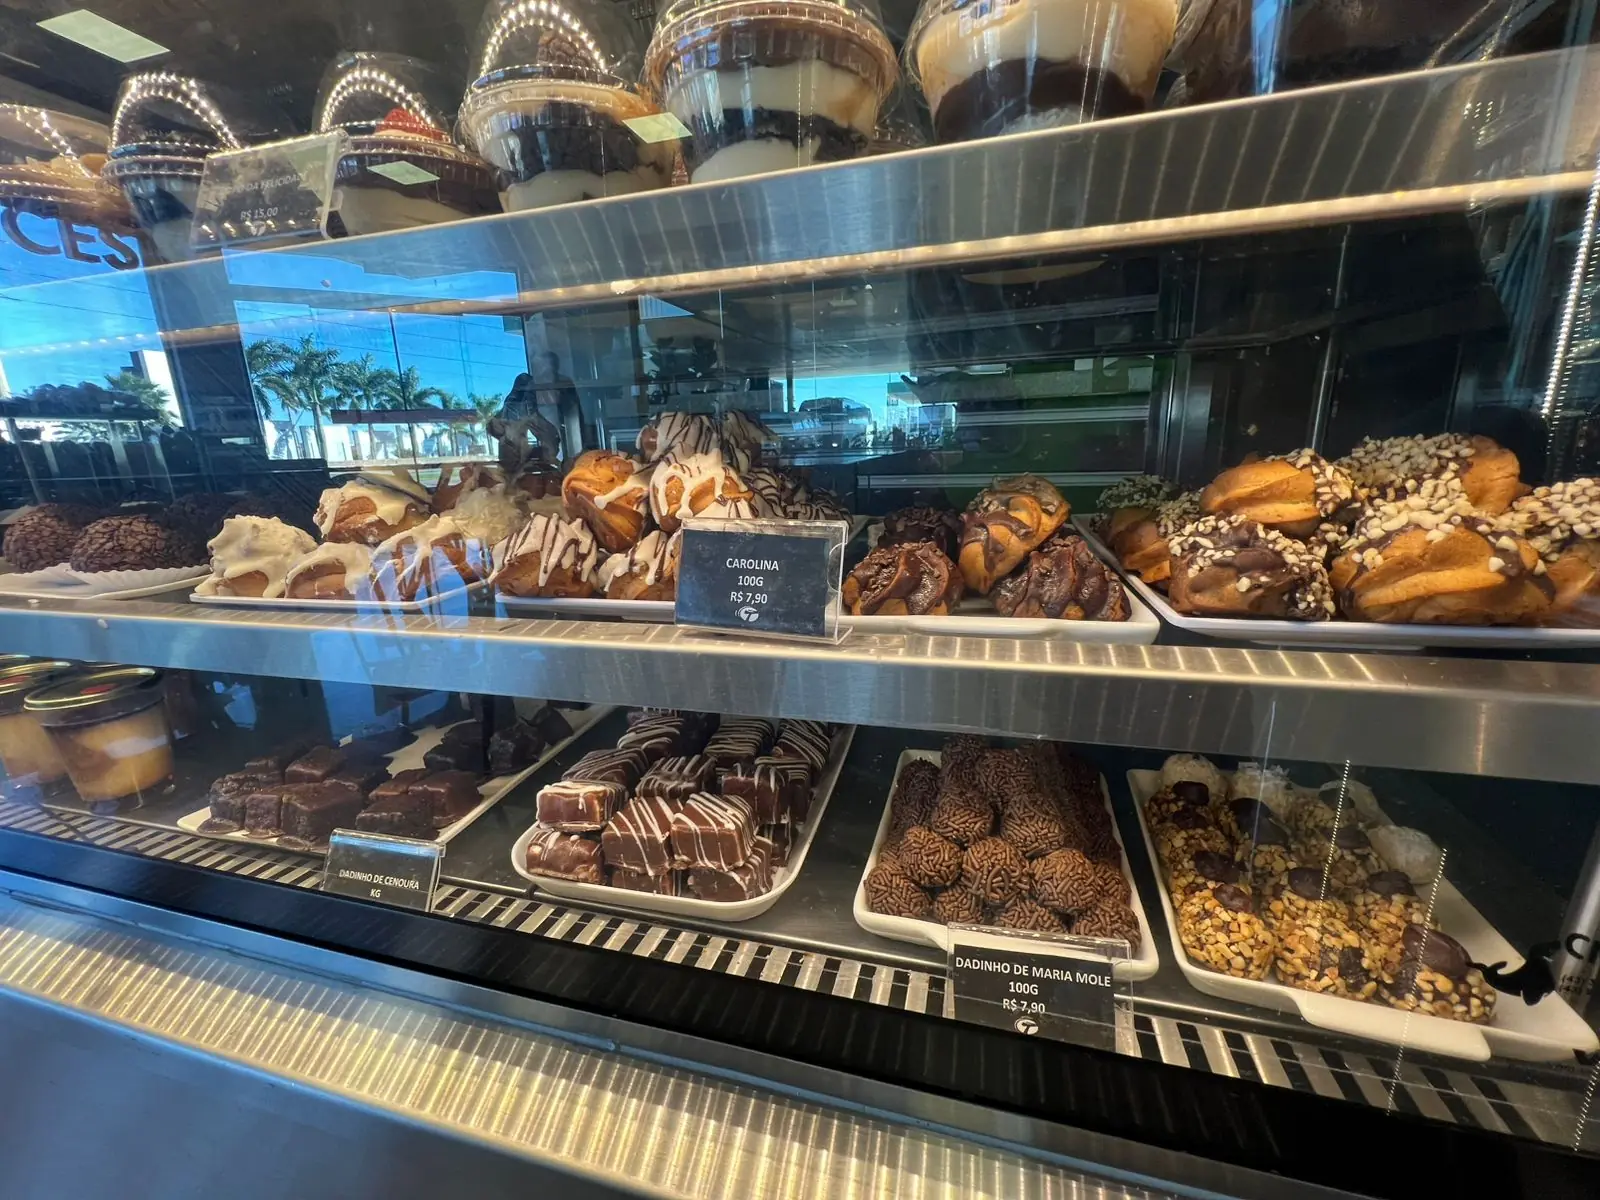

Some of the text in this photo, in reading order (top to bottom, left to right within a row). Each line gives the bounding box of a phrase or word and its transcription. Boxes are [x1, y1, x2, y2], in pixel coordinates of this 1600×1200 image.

[240, 206, 279, 220] R$ 15,00
[726, 558, 779, 571] CAROLINA
[737, 575, 764, 587] 100G
[730, 591, 768, 605] R$ 7,90
[339, 869, 420, 890] DADINHO DE CENOURA
[370, 888, 381, 898] KG
[955, 956, 1112, 987] DADINHO DE MARIA MOLE
[1008, 981, 1039, 995] 100G
[1003, 998, 1046, 1014] R$ 7,90
